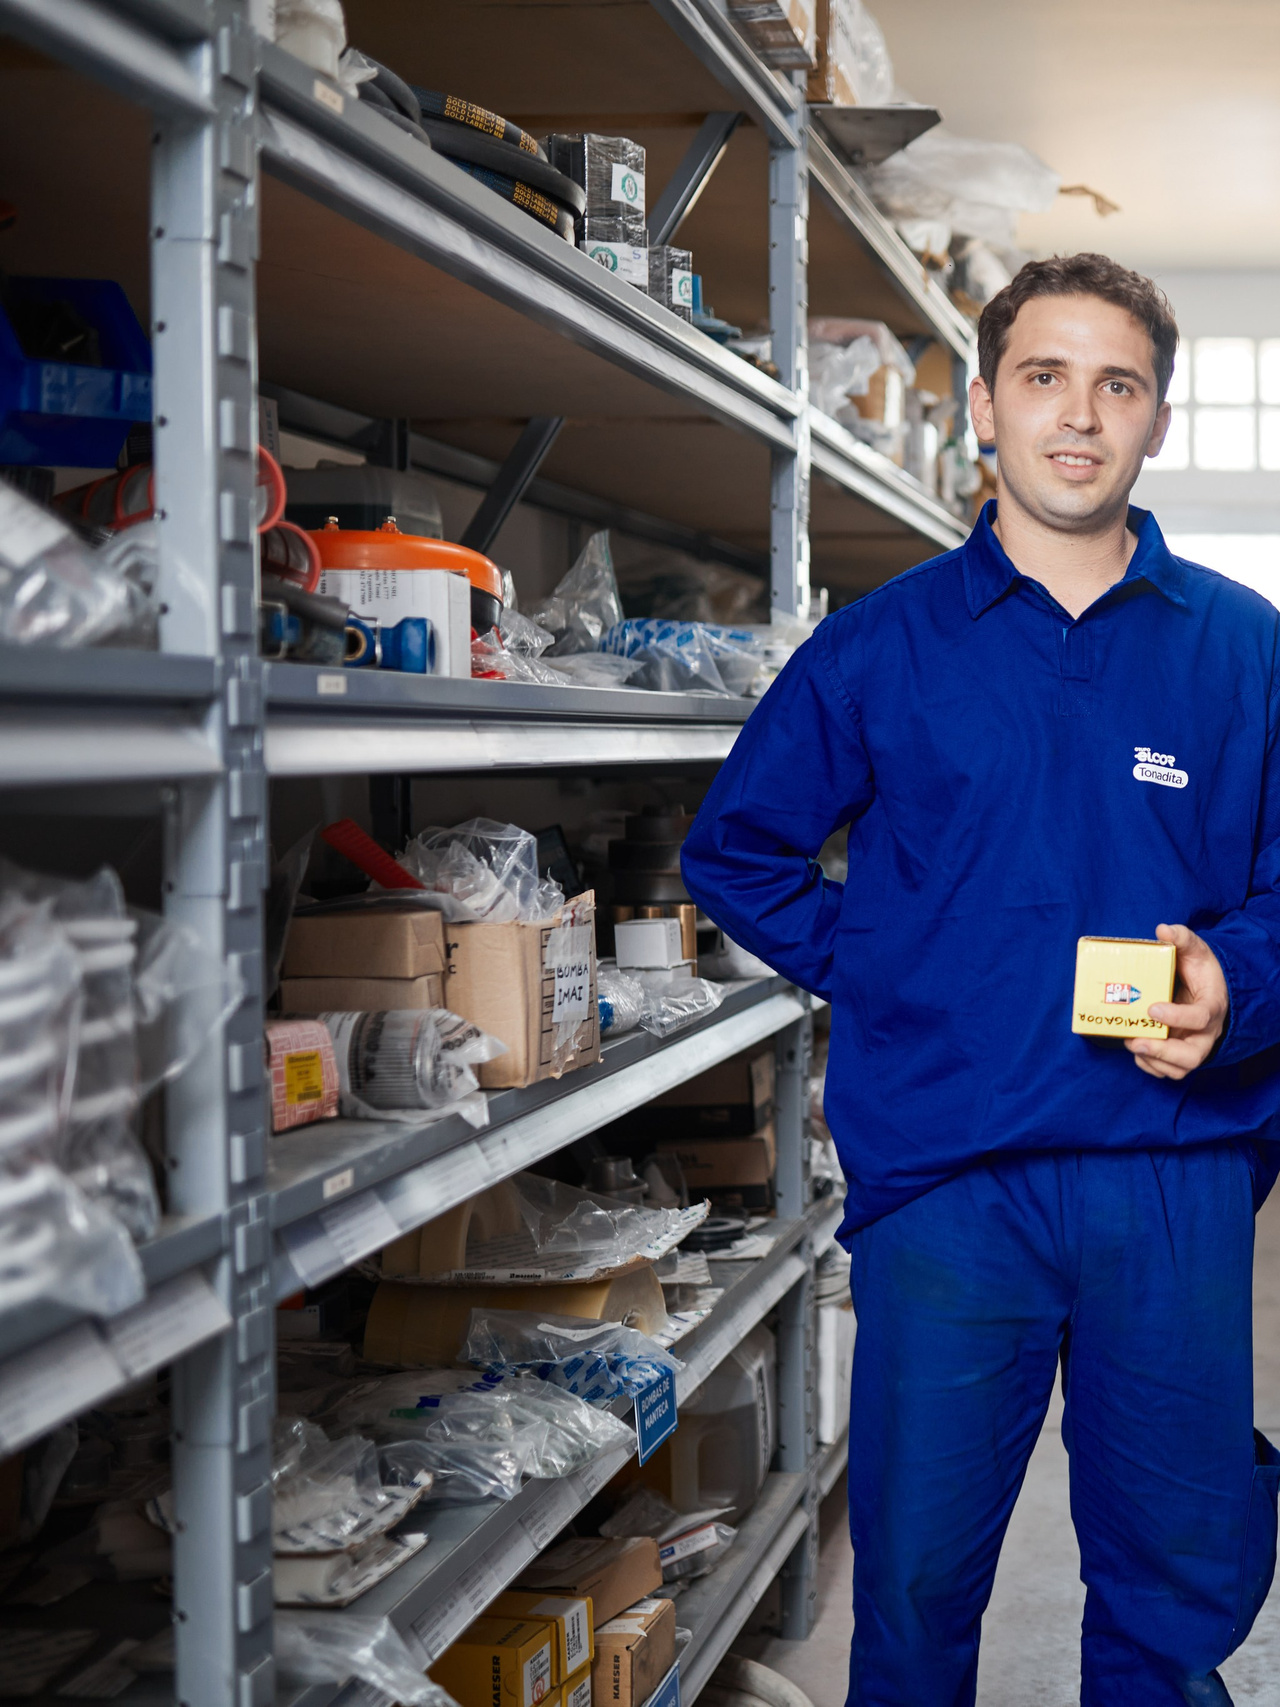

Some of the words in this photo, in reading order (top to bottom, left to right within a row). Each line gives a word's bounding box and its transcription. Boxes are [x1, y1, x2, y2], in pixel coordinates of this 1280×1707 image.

[446, 97, 467, 109] GOLD
[444, 109, 464, 121] GOLD
[446, 104, 466, 115] GOLD
[1139, 767, 1183, 785] Tonadita
[1107, 984, 1129, 992] TOP
[641, 1383, 663, 1413] BOMBAS
[662, 1377, 670, 1393] DE
[645, 1400, 669, 1431] MANTECA
